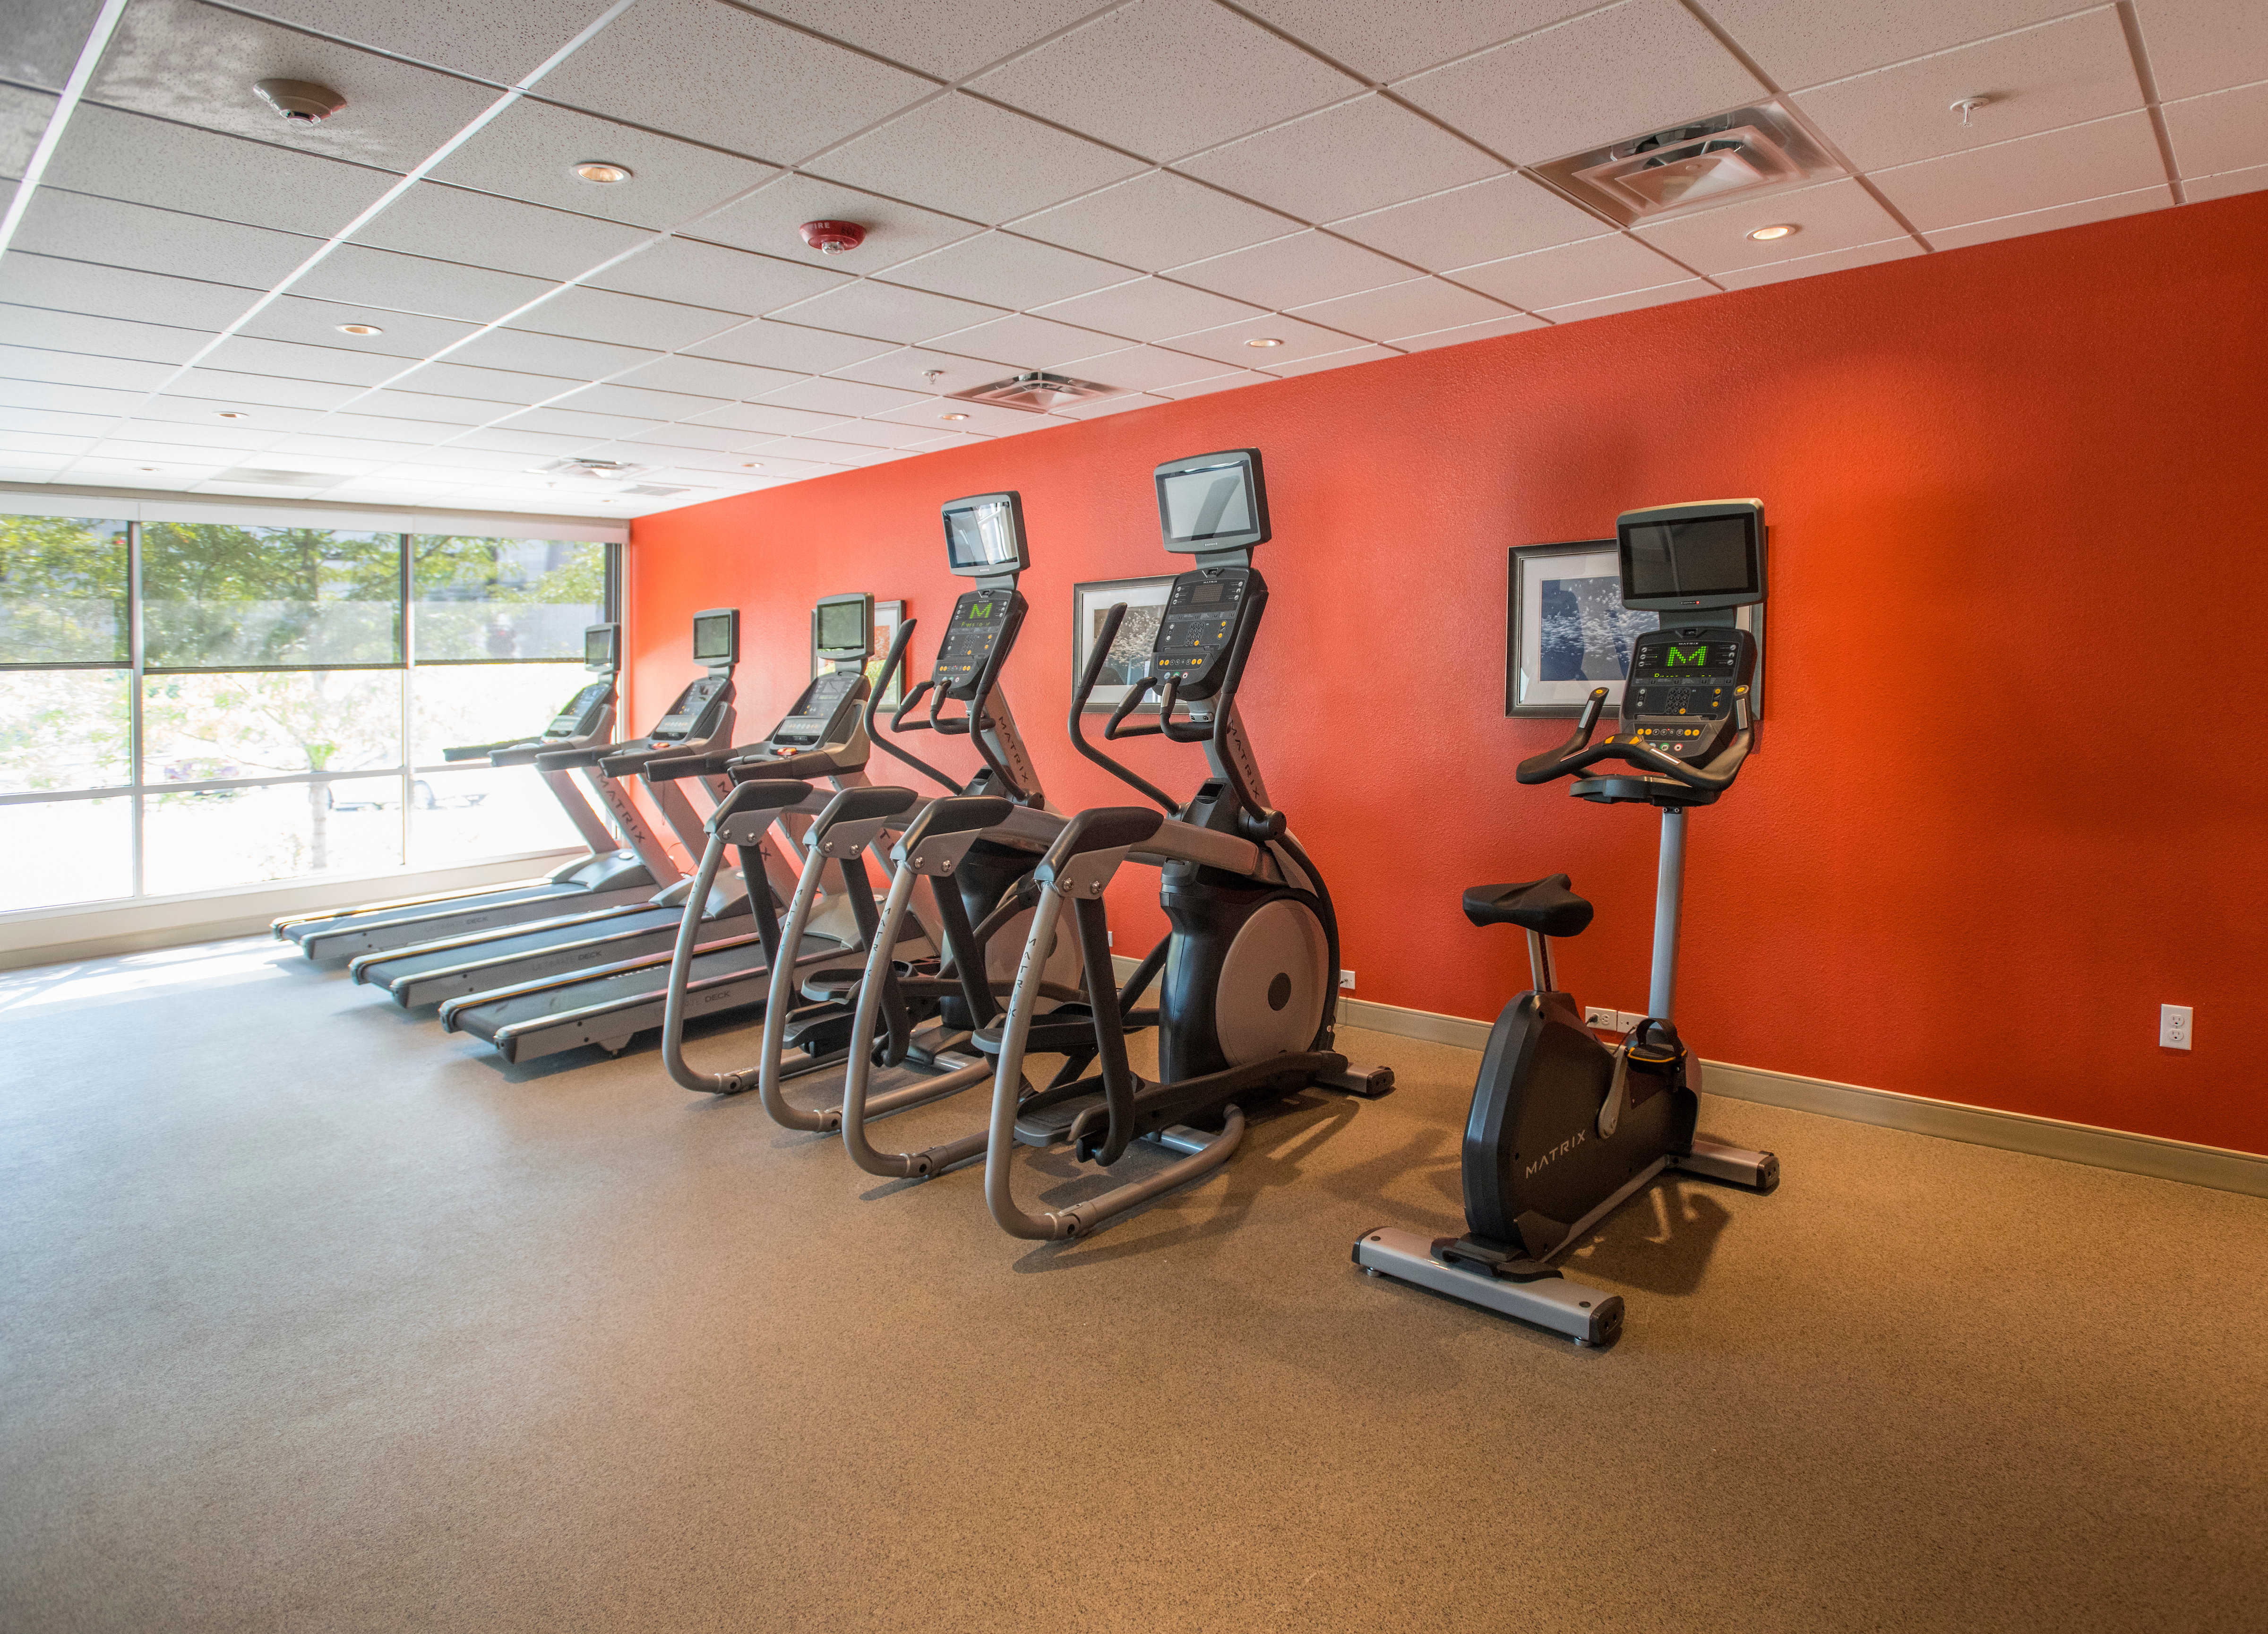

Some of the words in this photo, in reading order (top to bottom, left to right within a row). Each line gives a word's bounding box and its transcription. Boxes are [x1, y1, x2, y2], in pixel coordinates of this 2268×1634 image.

[809, 222, 830, 230] FIRE
[969, 602, 992, 619] M
[1667, 645, 1707, 667] M
[999, 716, 1028, 783] MATRIX
[1229, 719, 1259, 800] MATRIX
[596, 773, 645, 843] MATRIX
[578, 950, 602, 961] DECK
[1008, 938, 1037, 1017] MATRIX
[704, 990, 730, 1002] DECK
[1525, 1129, 1586, 1179] MATRIX
